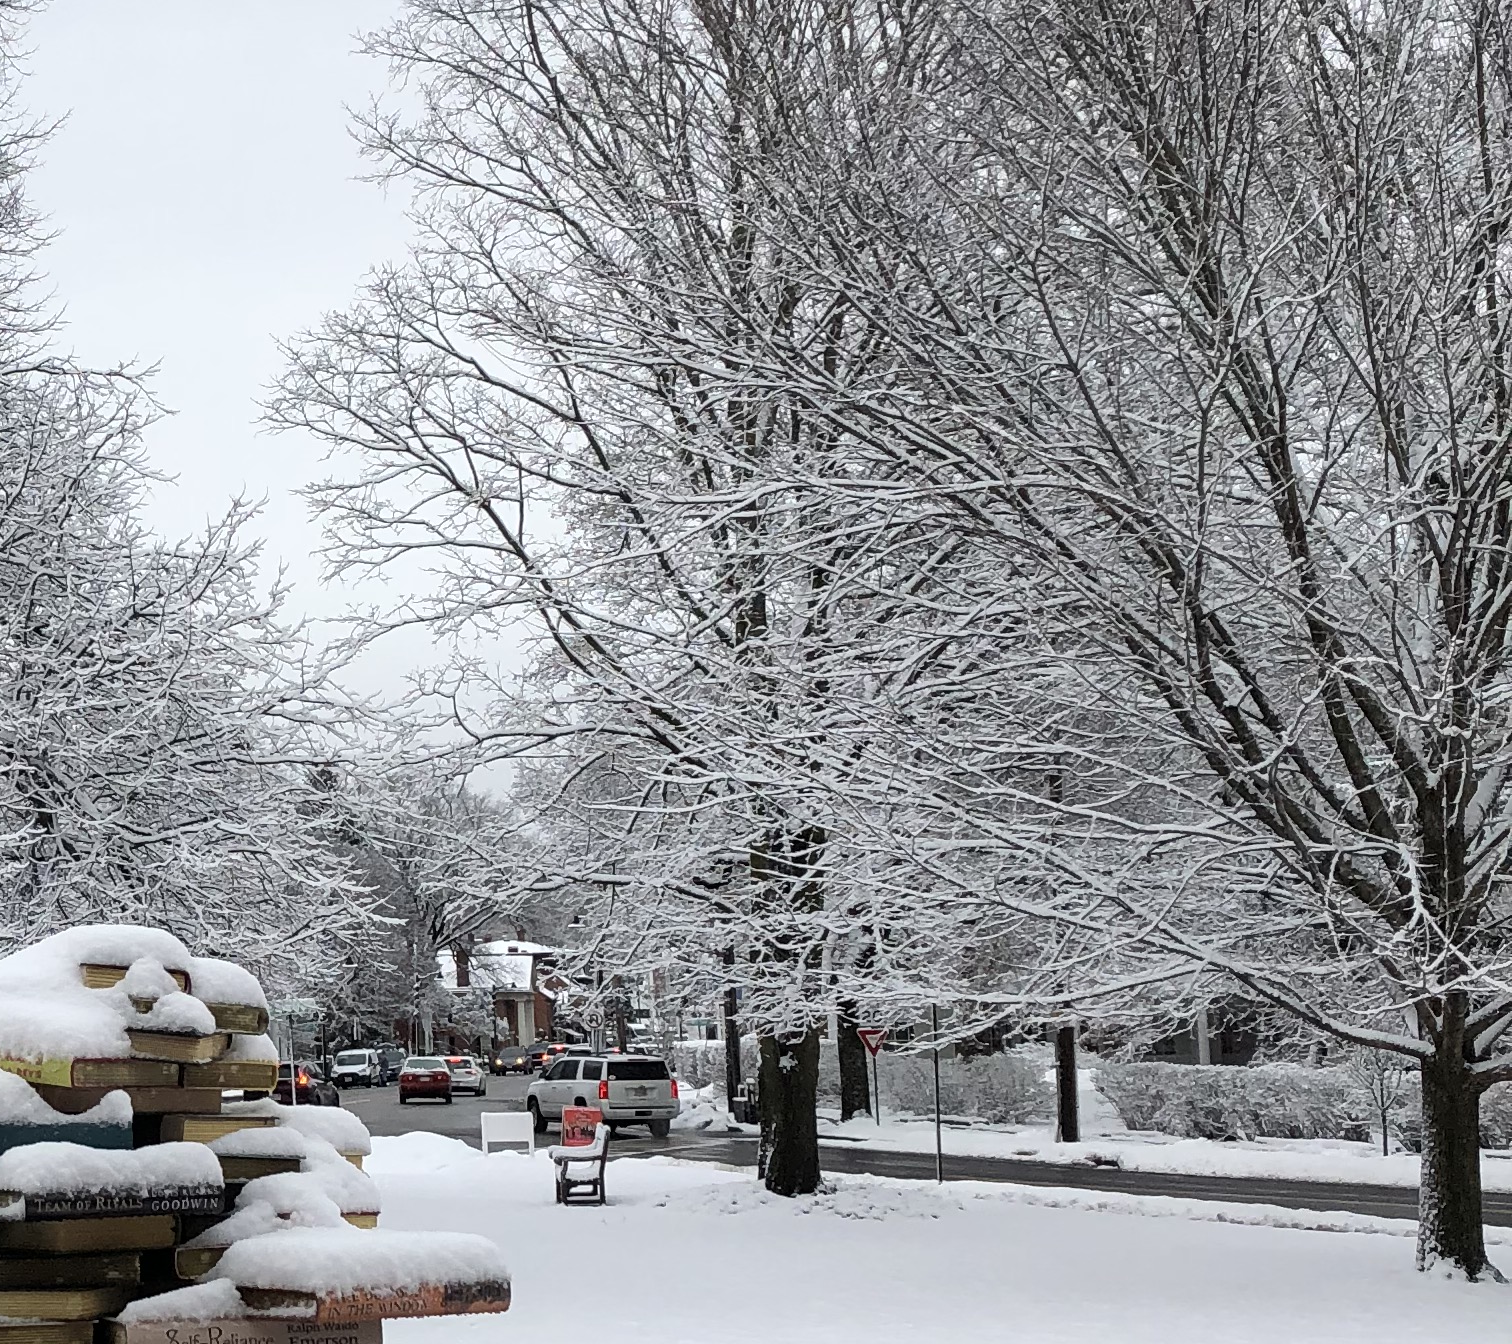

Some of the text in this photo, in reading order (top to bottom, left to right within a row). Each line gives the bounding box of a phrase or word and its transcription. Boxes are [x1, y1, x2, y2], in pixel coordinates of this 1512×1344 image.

[34, 1195, 144, 1212] TEAM OF RIVALS
[151, 1197, 219, 1211] GOODWIN
[328, 1306, 342, 1320] IN
[347, 1302, 375, 1317] THE
[286, 1320, 360, 1336] Ralph Waldo
